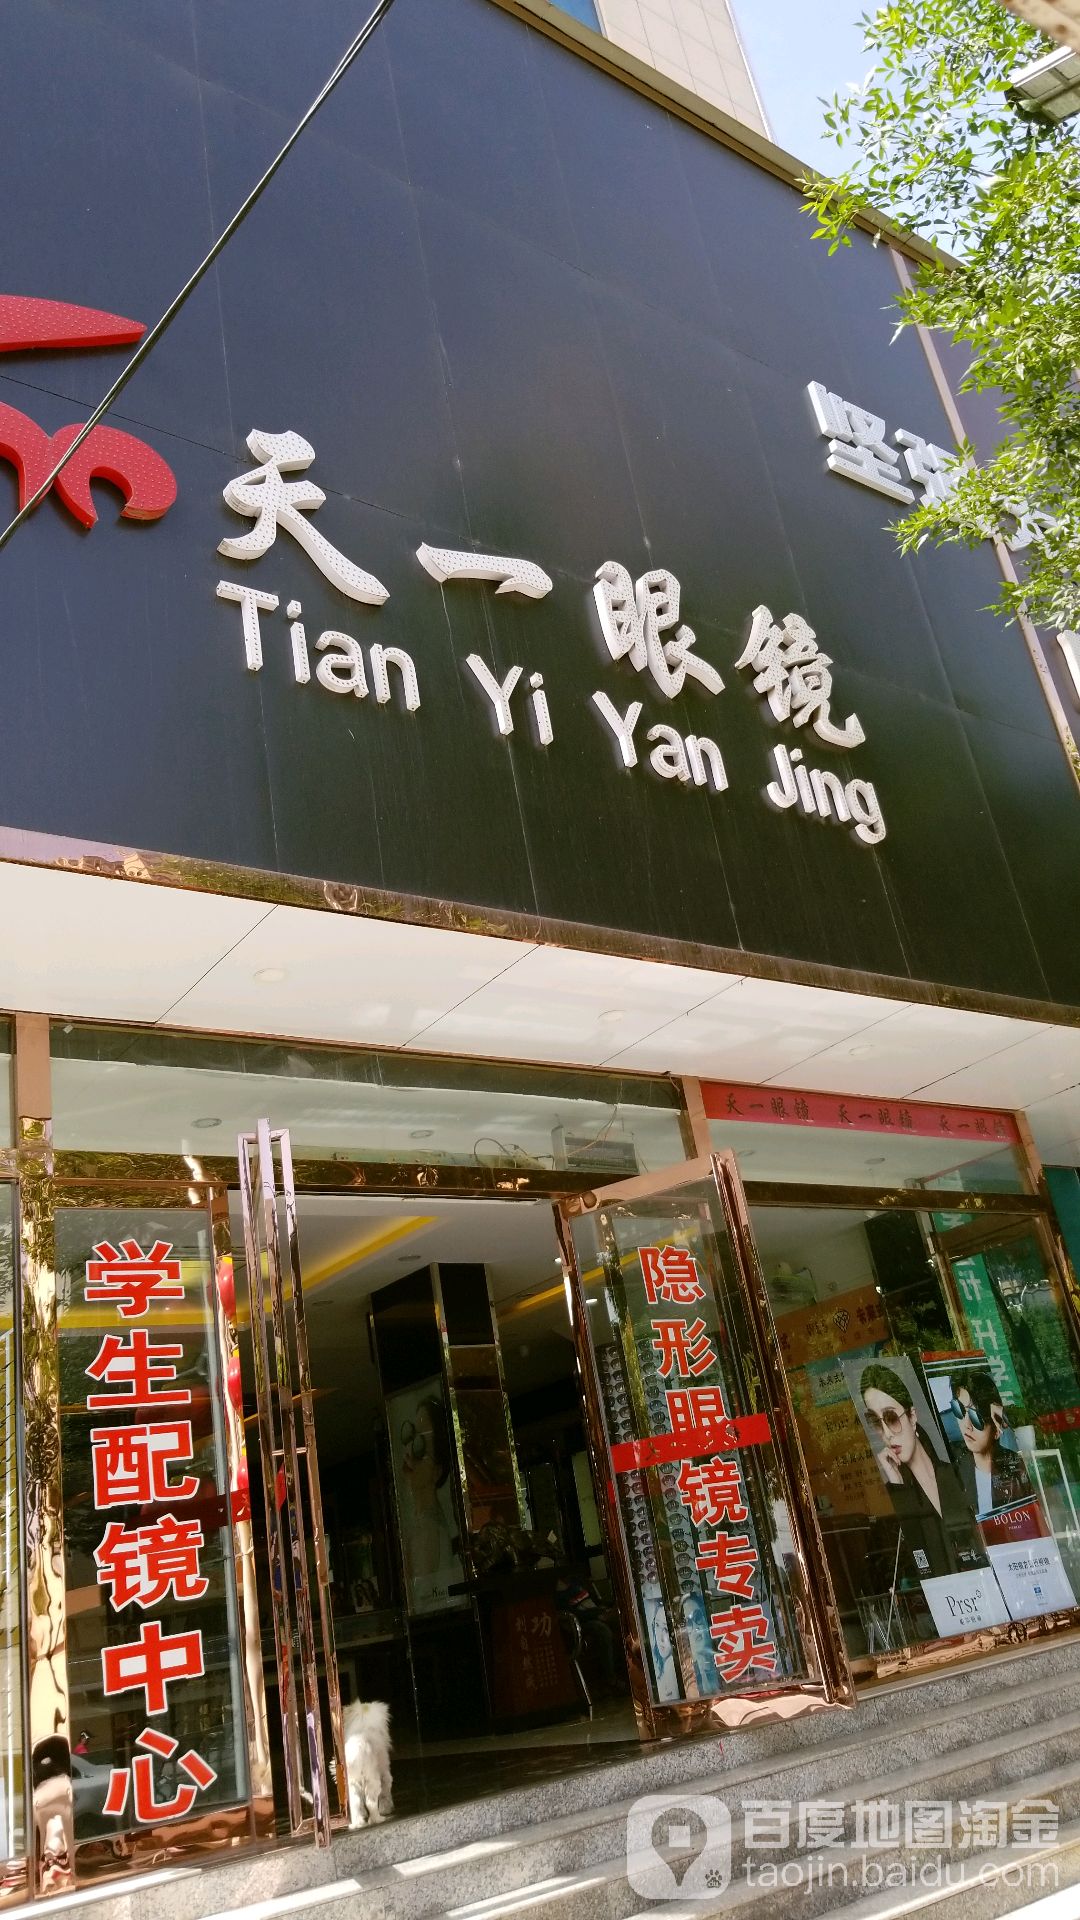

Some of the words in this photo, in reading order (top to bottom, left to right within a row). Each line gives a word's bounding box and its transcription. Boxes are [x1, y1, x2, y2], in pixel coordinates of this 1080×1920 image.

[216, 580, 421, 712] Tian
[465, 653, 554, 746] Yi
[592, 691, 729, 792] Yan
[766, 743, 886, 845] Jing
[217, 429, 865, 748] 天一眼镜
[84, 1239, 218, 1823] 学生配镜中心
[637, 1244, 778, 1683] 隐形眼镜专卖
[993, 1510, 1032, 1526] BOLON
